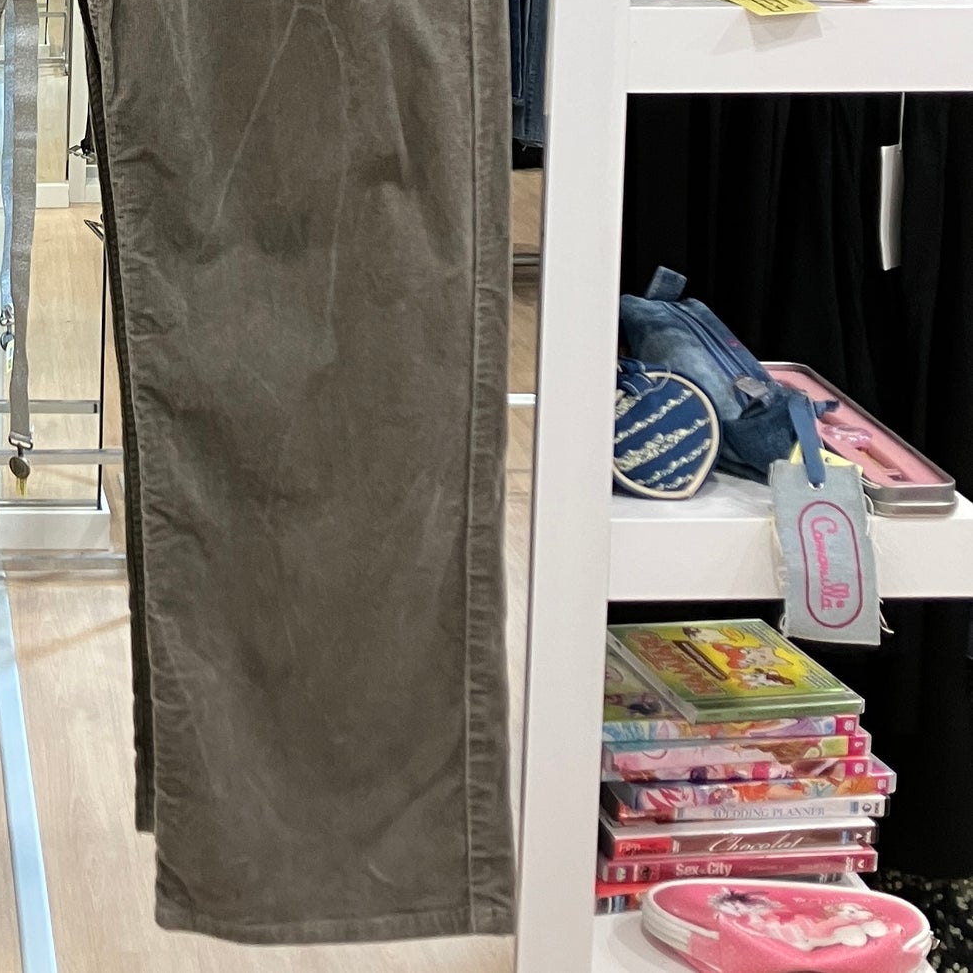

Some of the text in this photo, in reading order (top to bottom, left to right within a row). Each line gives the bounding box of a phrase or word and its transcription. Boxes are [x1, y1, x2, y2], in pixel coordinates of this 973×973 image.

[772, 807, 825, 817] PLANNER
[709, 833, 804, 852] Chocolat
[676, 863, 700, 876] Sex
[707, 861, 733, 877] City
